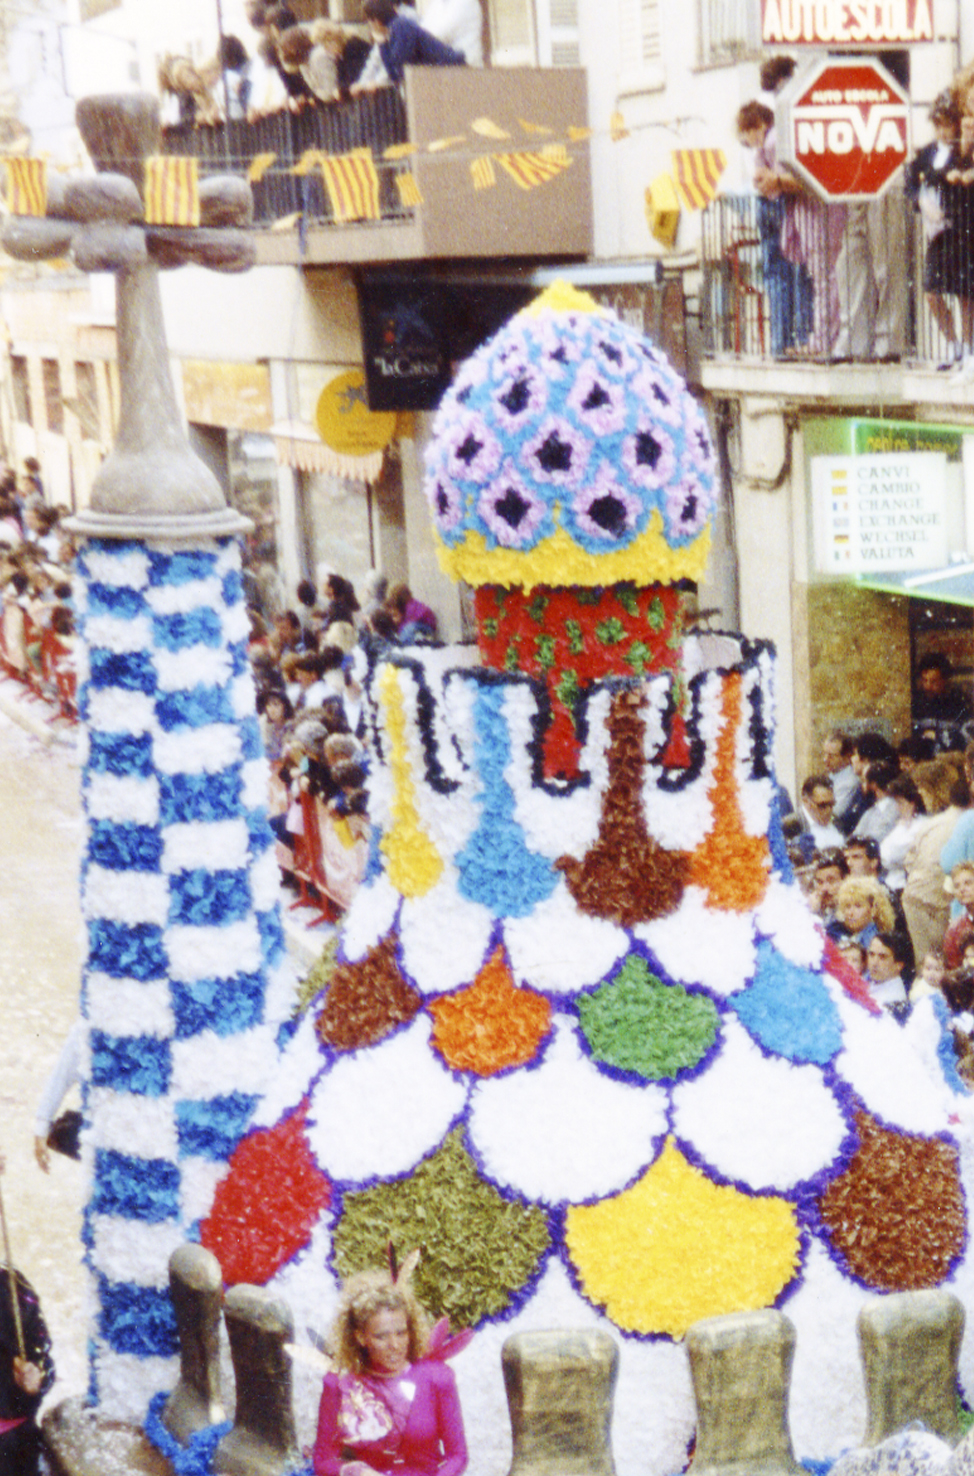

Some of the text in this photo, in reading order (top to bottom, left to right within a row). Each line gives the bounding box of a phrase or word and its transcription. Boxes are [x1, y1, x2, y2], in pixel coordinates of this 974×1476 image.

[763, 0, 933, 41] AUTOESCOLA
[797, 106, 906, 154] NOVA
[857, 466, 910, 479] CANVI
[857, 482, 921, 495] CAMBIO
[858, 498, 923, 511] CHANGE
[859, 513, 940, 527] EXCHANGE
[860, 530, 929, 543] WECHSEL
[860, 547, 915, 560] VALUTA
